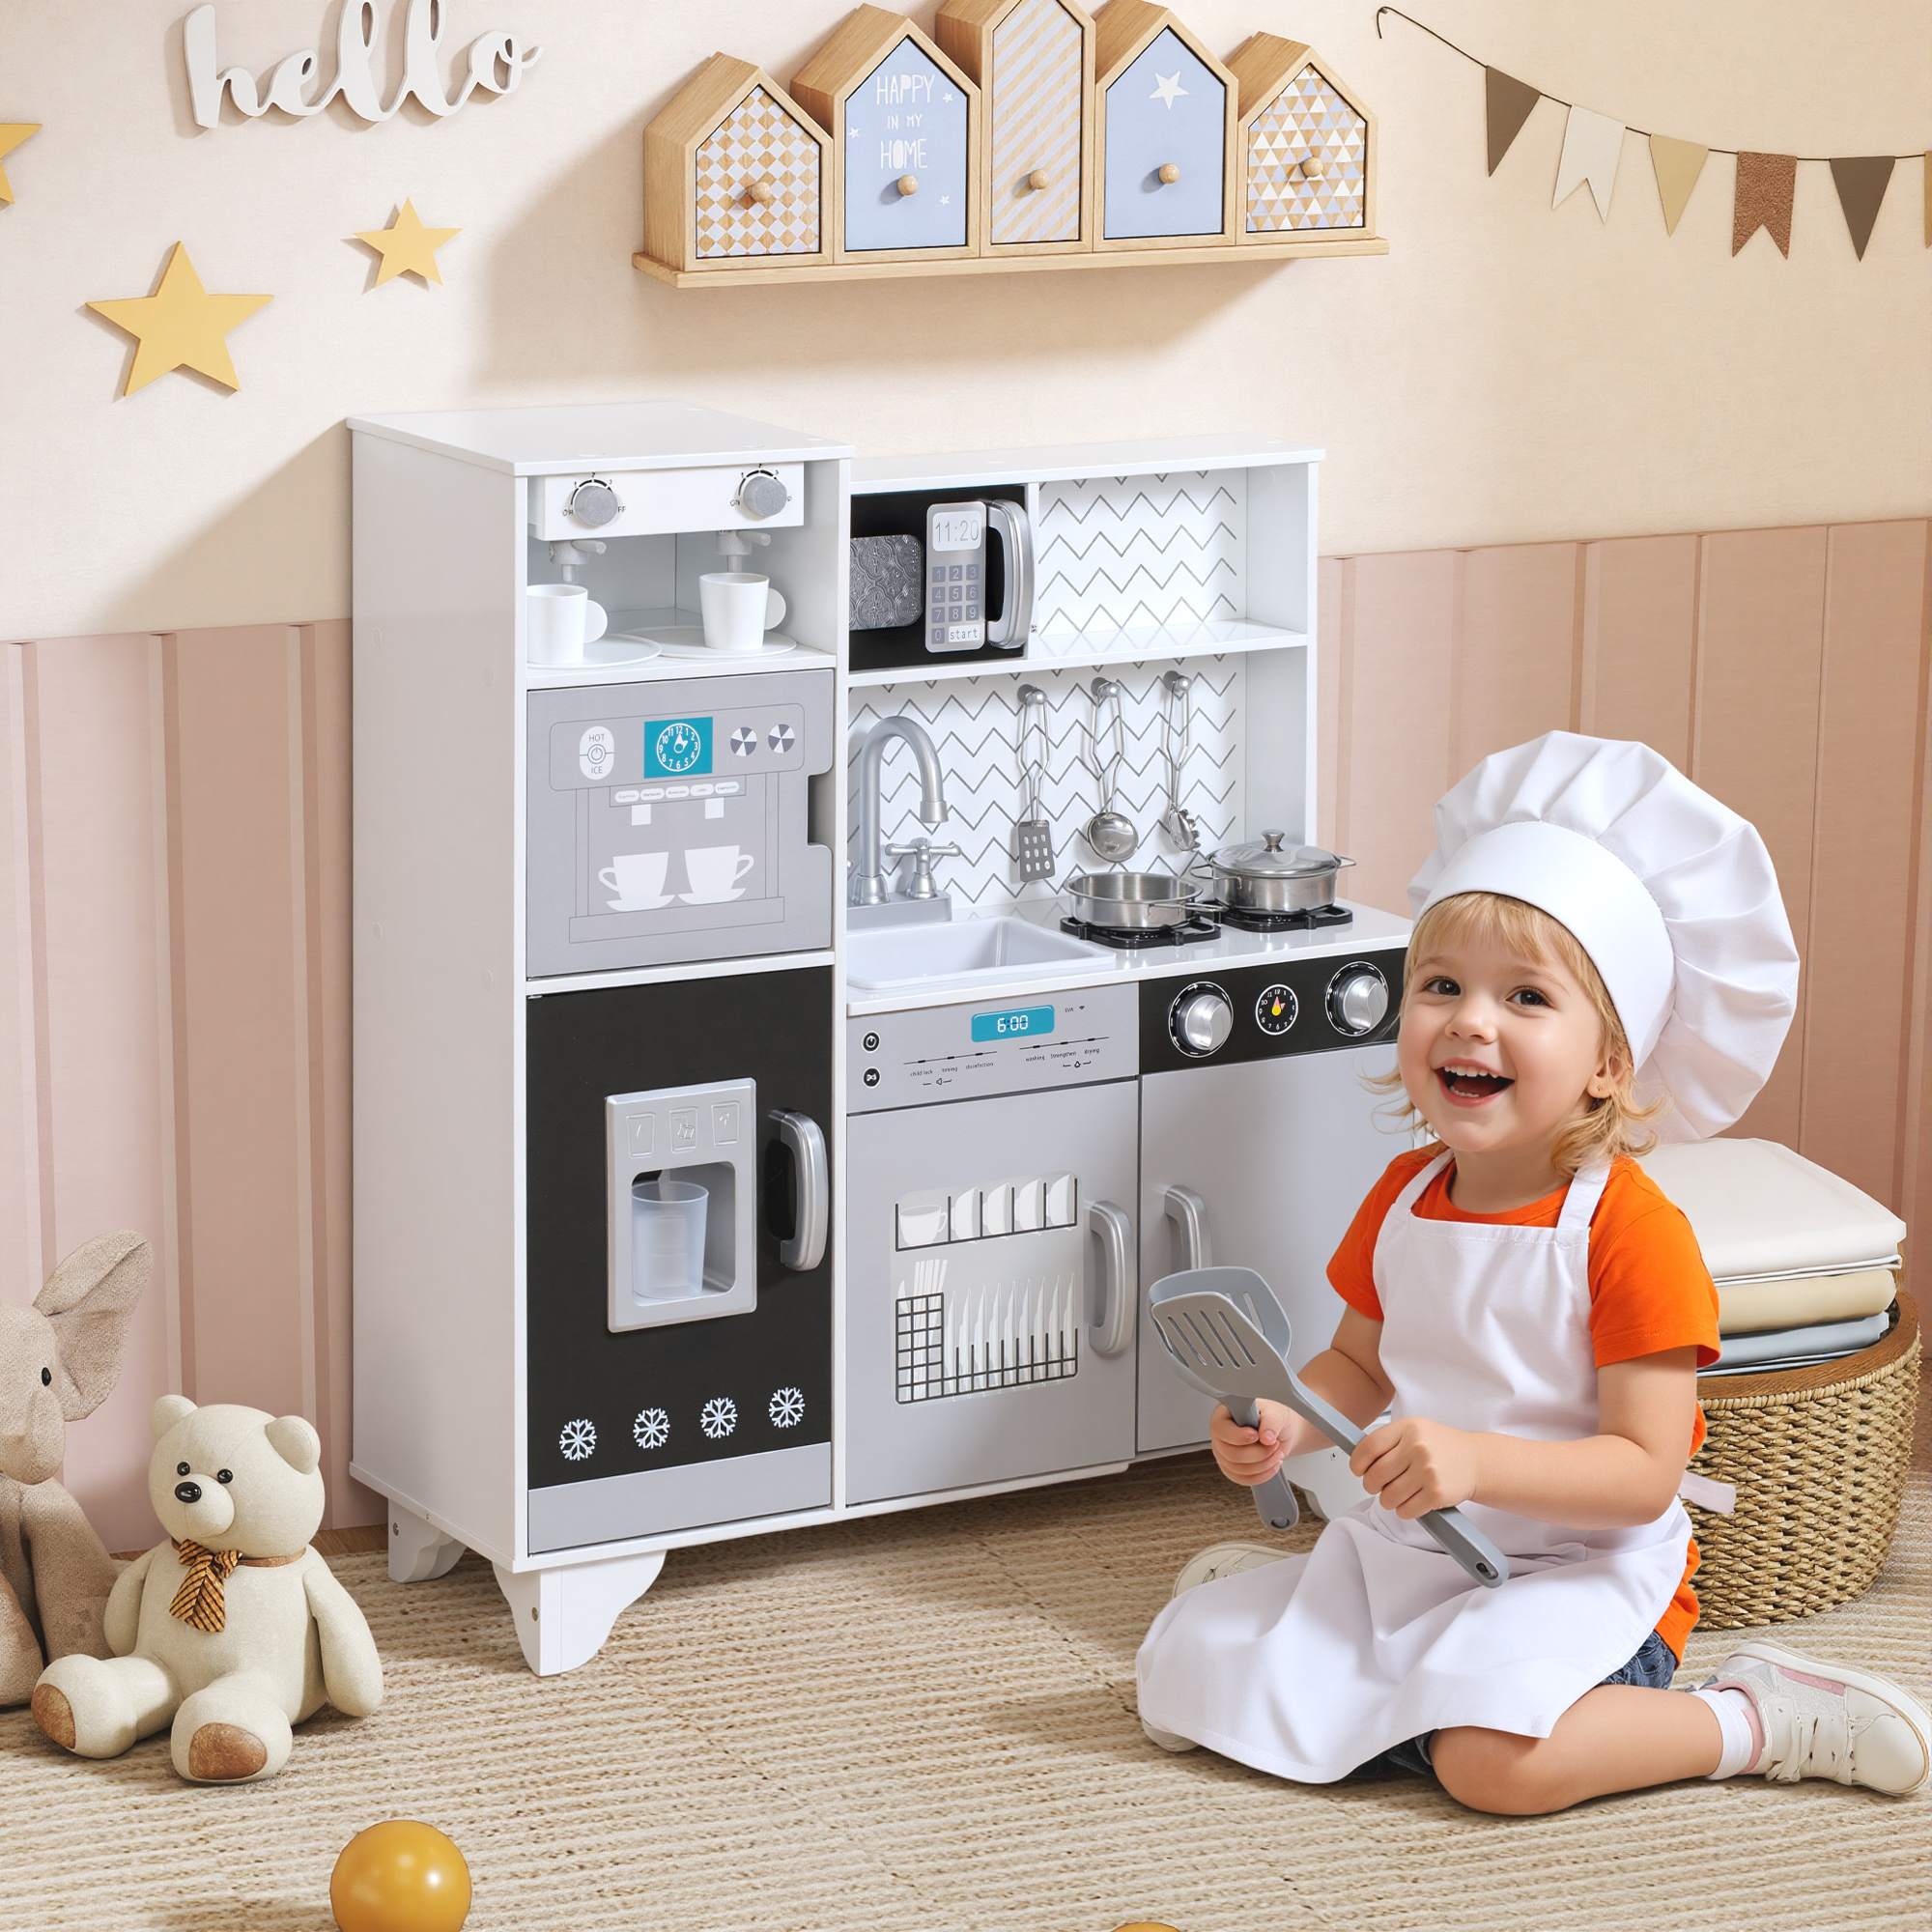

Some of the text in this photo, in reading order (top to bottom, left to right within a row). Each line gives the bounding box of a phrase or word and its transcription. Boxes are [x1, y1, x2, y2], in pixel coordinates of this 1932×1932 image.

[185, 0, 542, 128] hello
[876, 73, 935, 105] HAPPY
[888, 114, 923, 129] IN MY
[880, 138, 928, 169] HOME
[934, 520, 980, 543] 11:20
[936, 566, 977, 581] 1 2 3
[934, 586, 977, 600] 4 5 6
[935, 607, 977, 621] 7 8 9
[934, 627, 979, 641] 0 start
[668, 727, 674, 736] 11
[675, 724, 683, 734] 12
[685, 727, 689, 736] 1
[588, 733, 606, 743] HOT
[662, 734, 668, 744] 10
[691, 731, 696, 741] 2
[659, 744, 664, 753] 9
[694, 741, 698, 751] 3
[662, 753, 667, 762] 8
[691, 751, 696, 759] 4
[668, 758, 673, 768] 7
[675, 760, 681, 770] 6
[684, 757, 689, 767] 5
[590, 765, 603, 775] ICE
[997, 1014, 1029, 1034] 6:00
